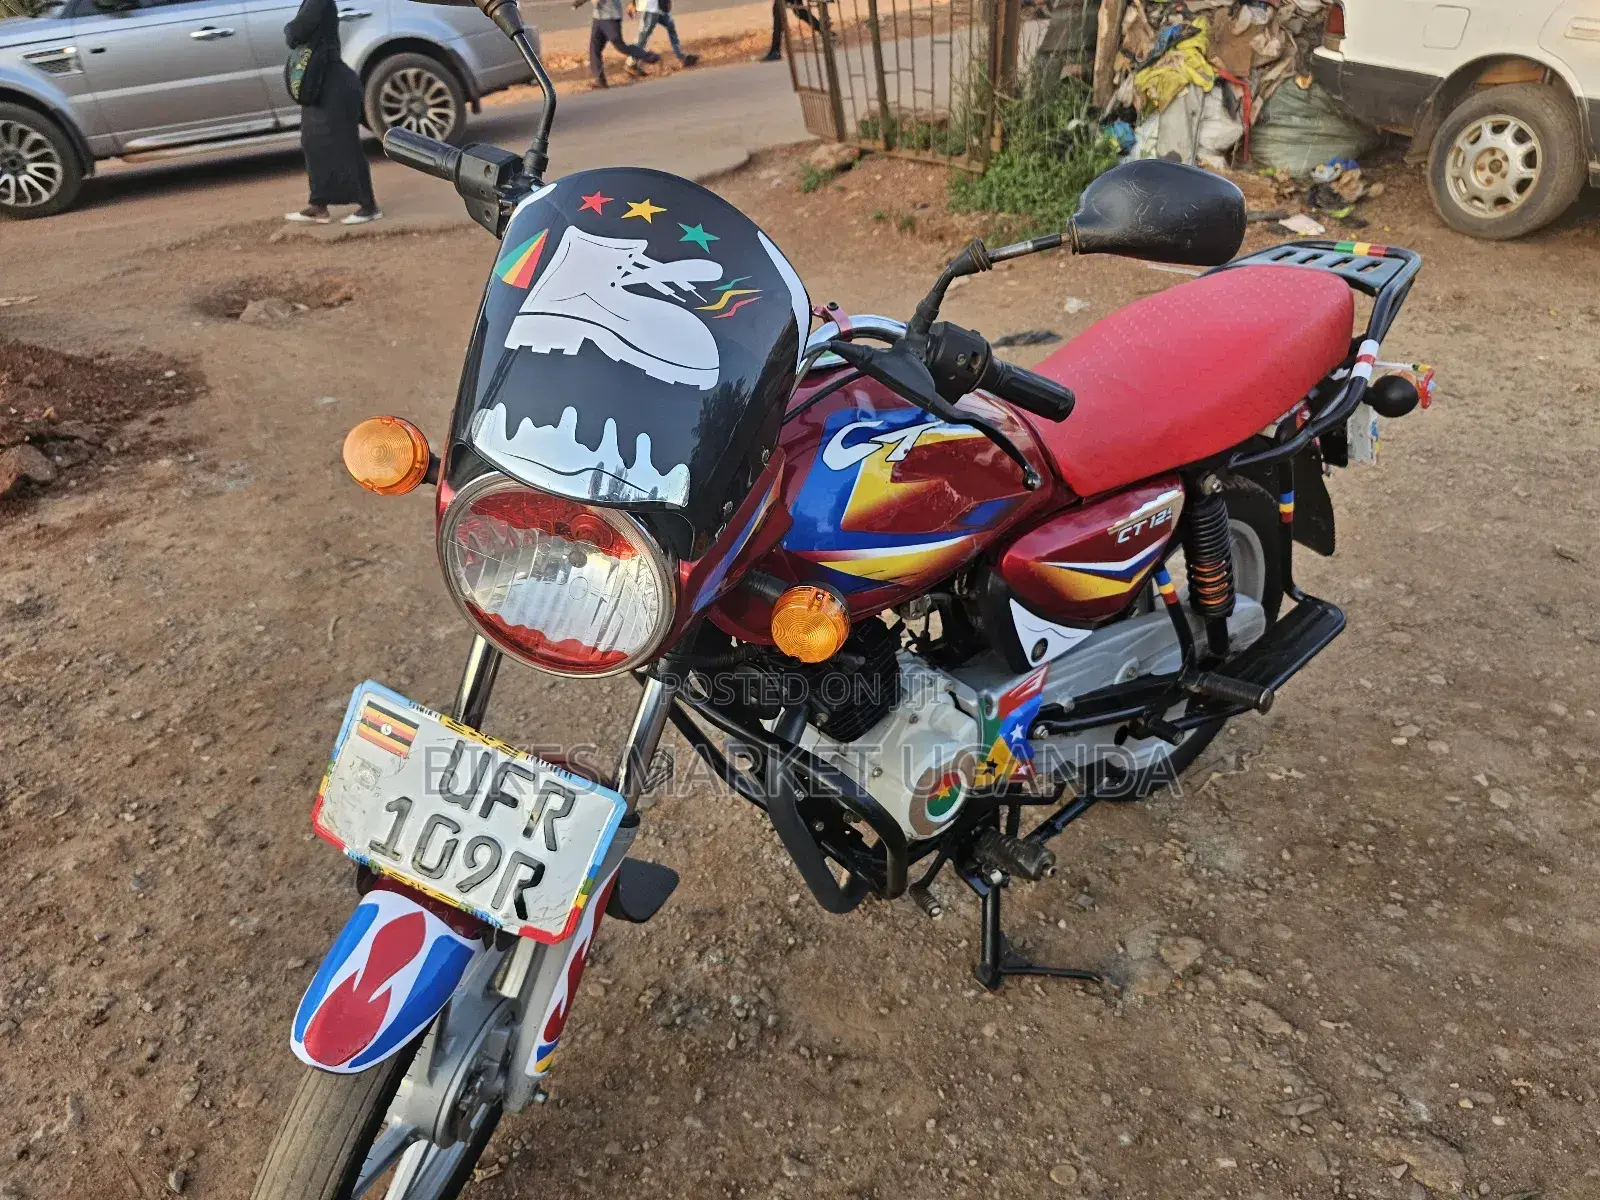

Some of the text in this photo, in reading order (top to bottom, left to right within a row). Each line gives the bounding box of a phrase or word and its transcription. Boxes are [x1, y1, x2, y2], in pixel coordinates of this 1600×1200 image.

[822, 420, 943, 471] CT
[1117, 519, 1148, 544] CT
[438, 739, 576, 852] UFR
[368, 795, 546, 921] 109R
